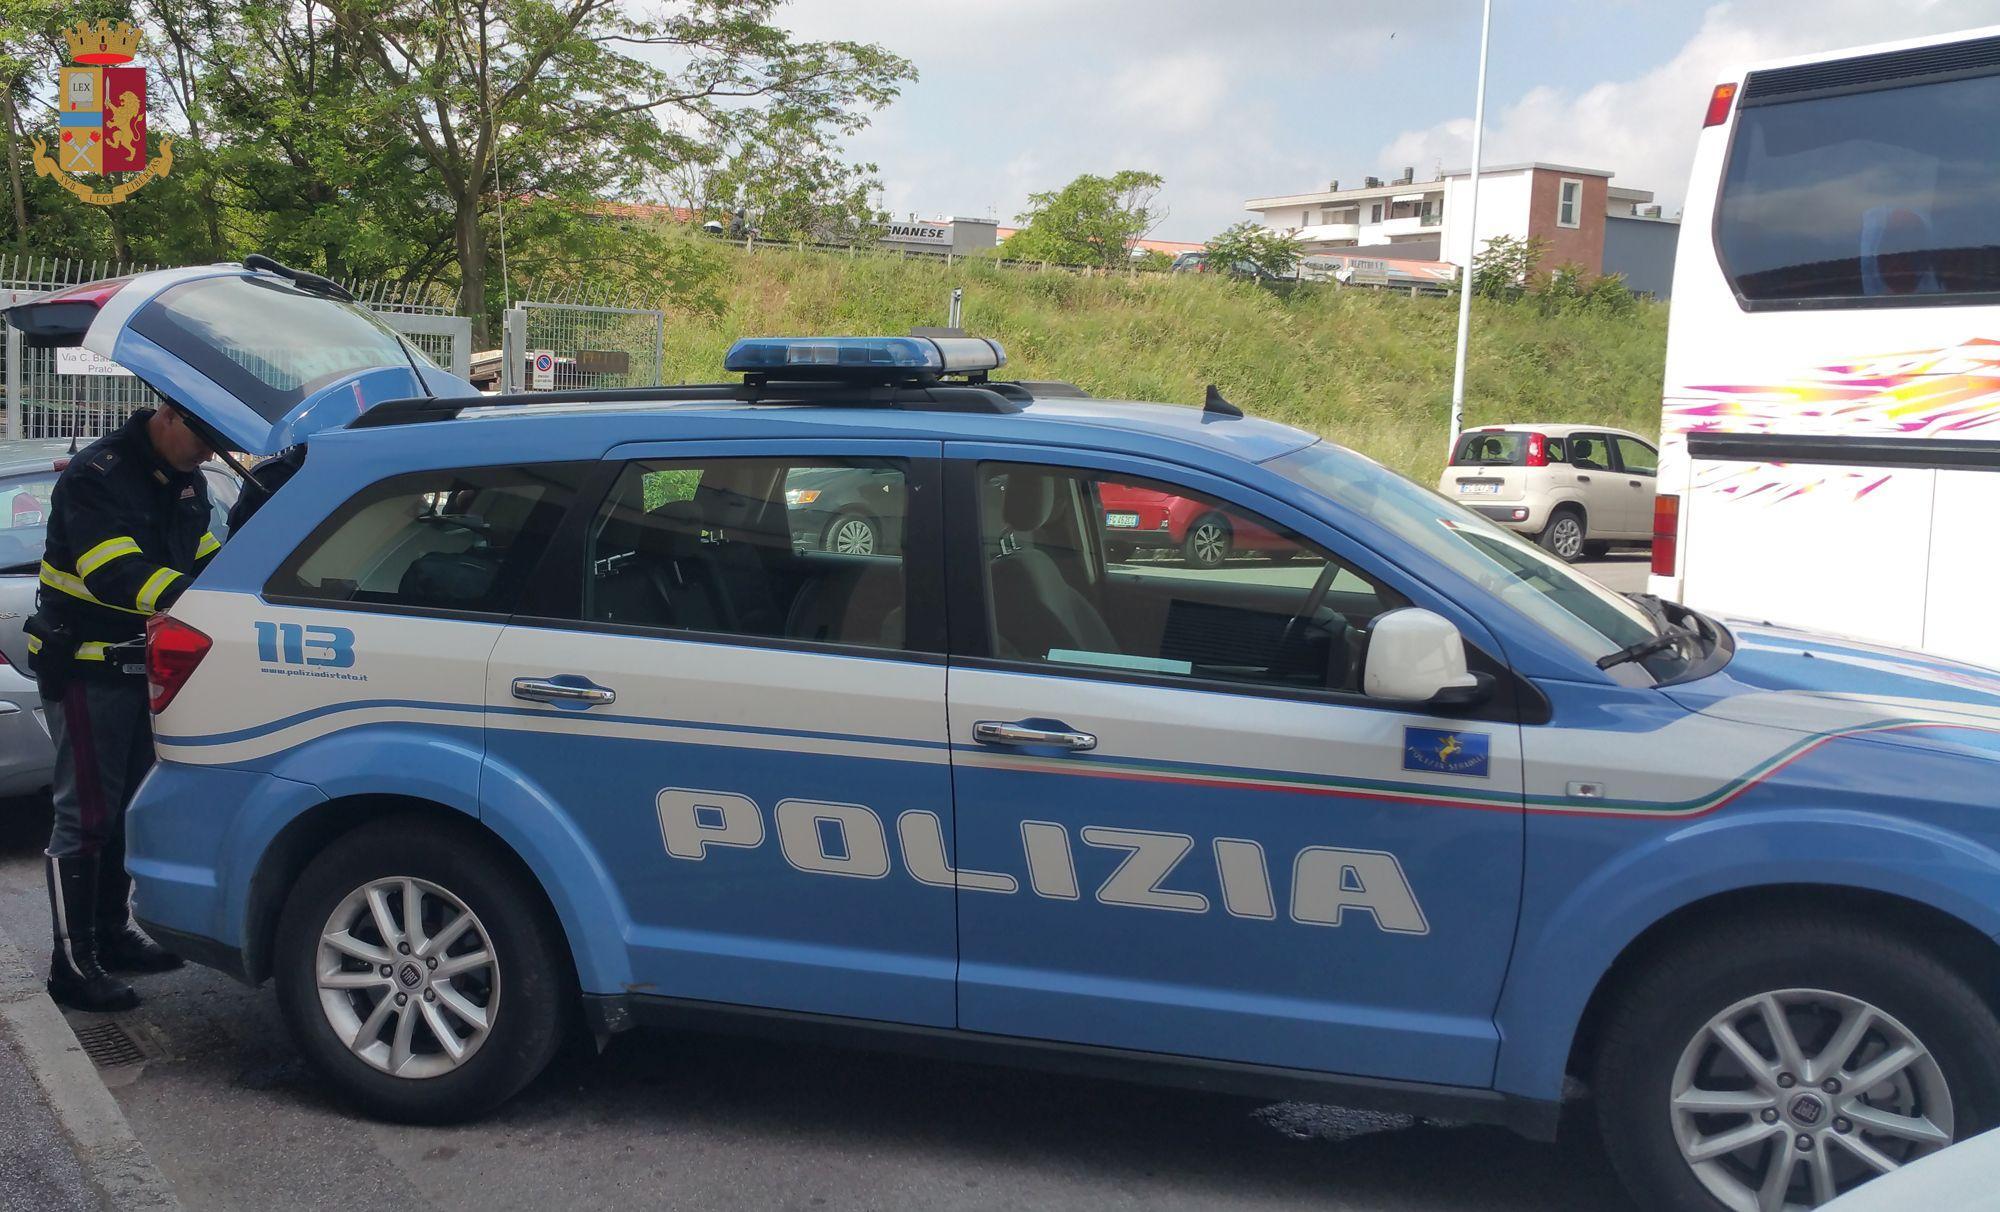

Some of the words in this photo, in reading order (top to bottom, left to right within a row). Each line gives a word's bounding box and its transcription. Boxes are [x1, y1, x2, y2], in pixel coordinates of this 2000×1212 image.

[885, 225, 944, 238] GNANESE
[61, 353, 77, 362] Via
[88, 365, 113, 374] Prato
[254, 621, 356, 668] 113
[261, 667, 369, 681] www.poliziadistato.it
[656, 786, 1431, 935] POLIZIA
